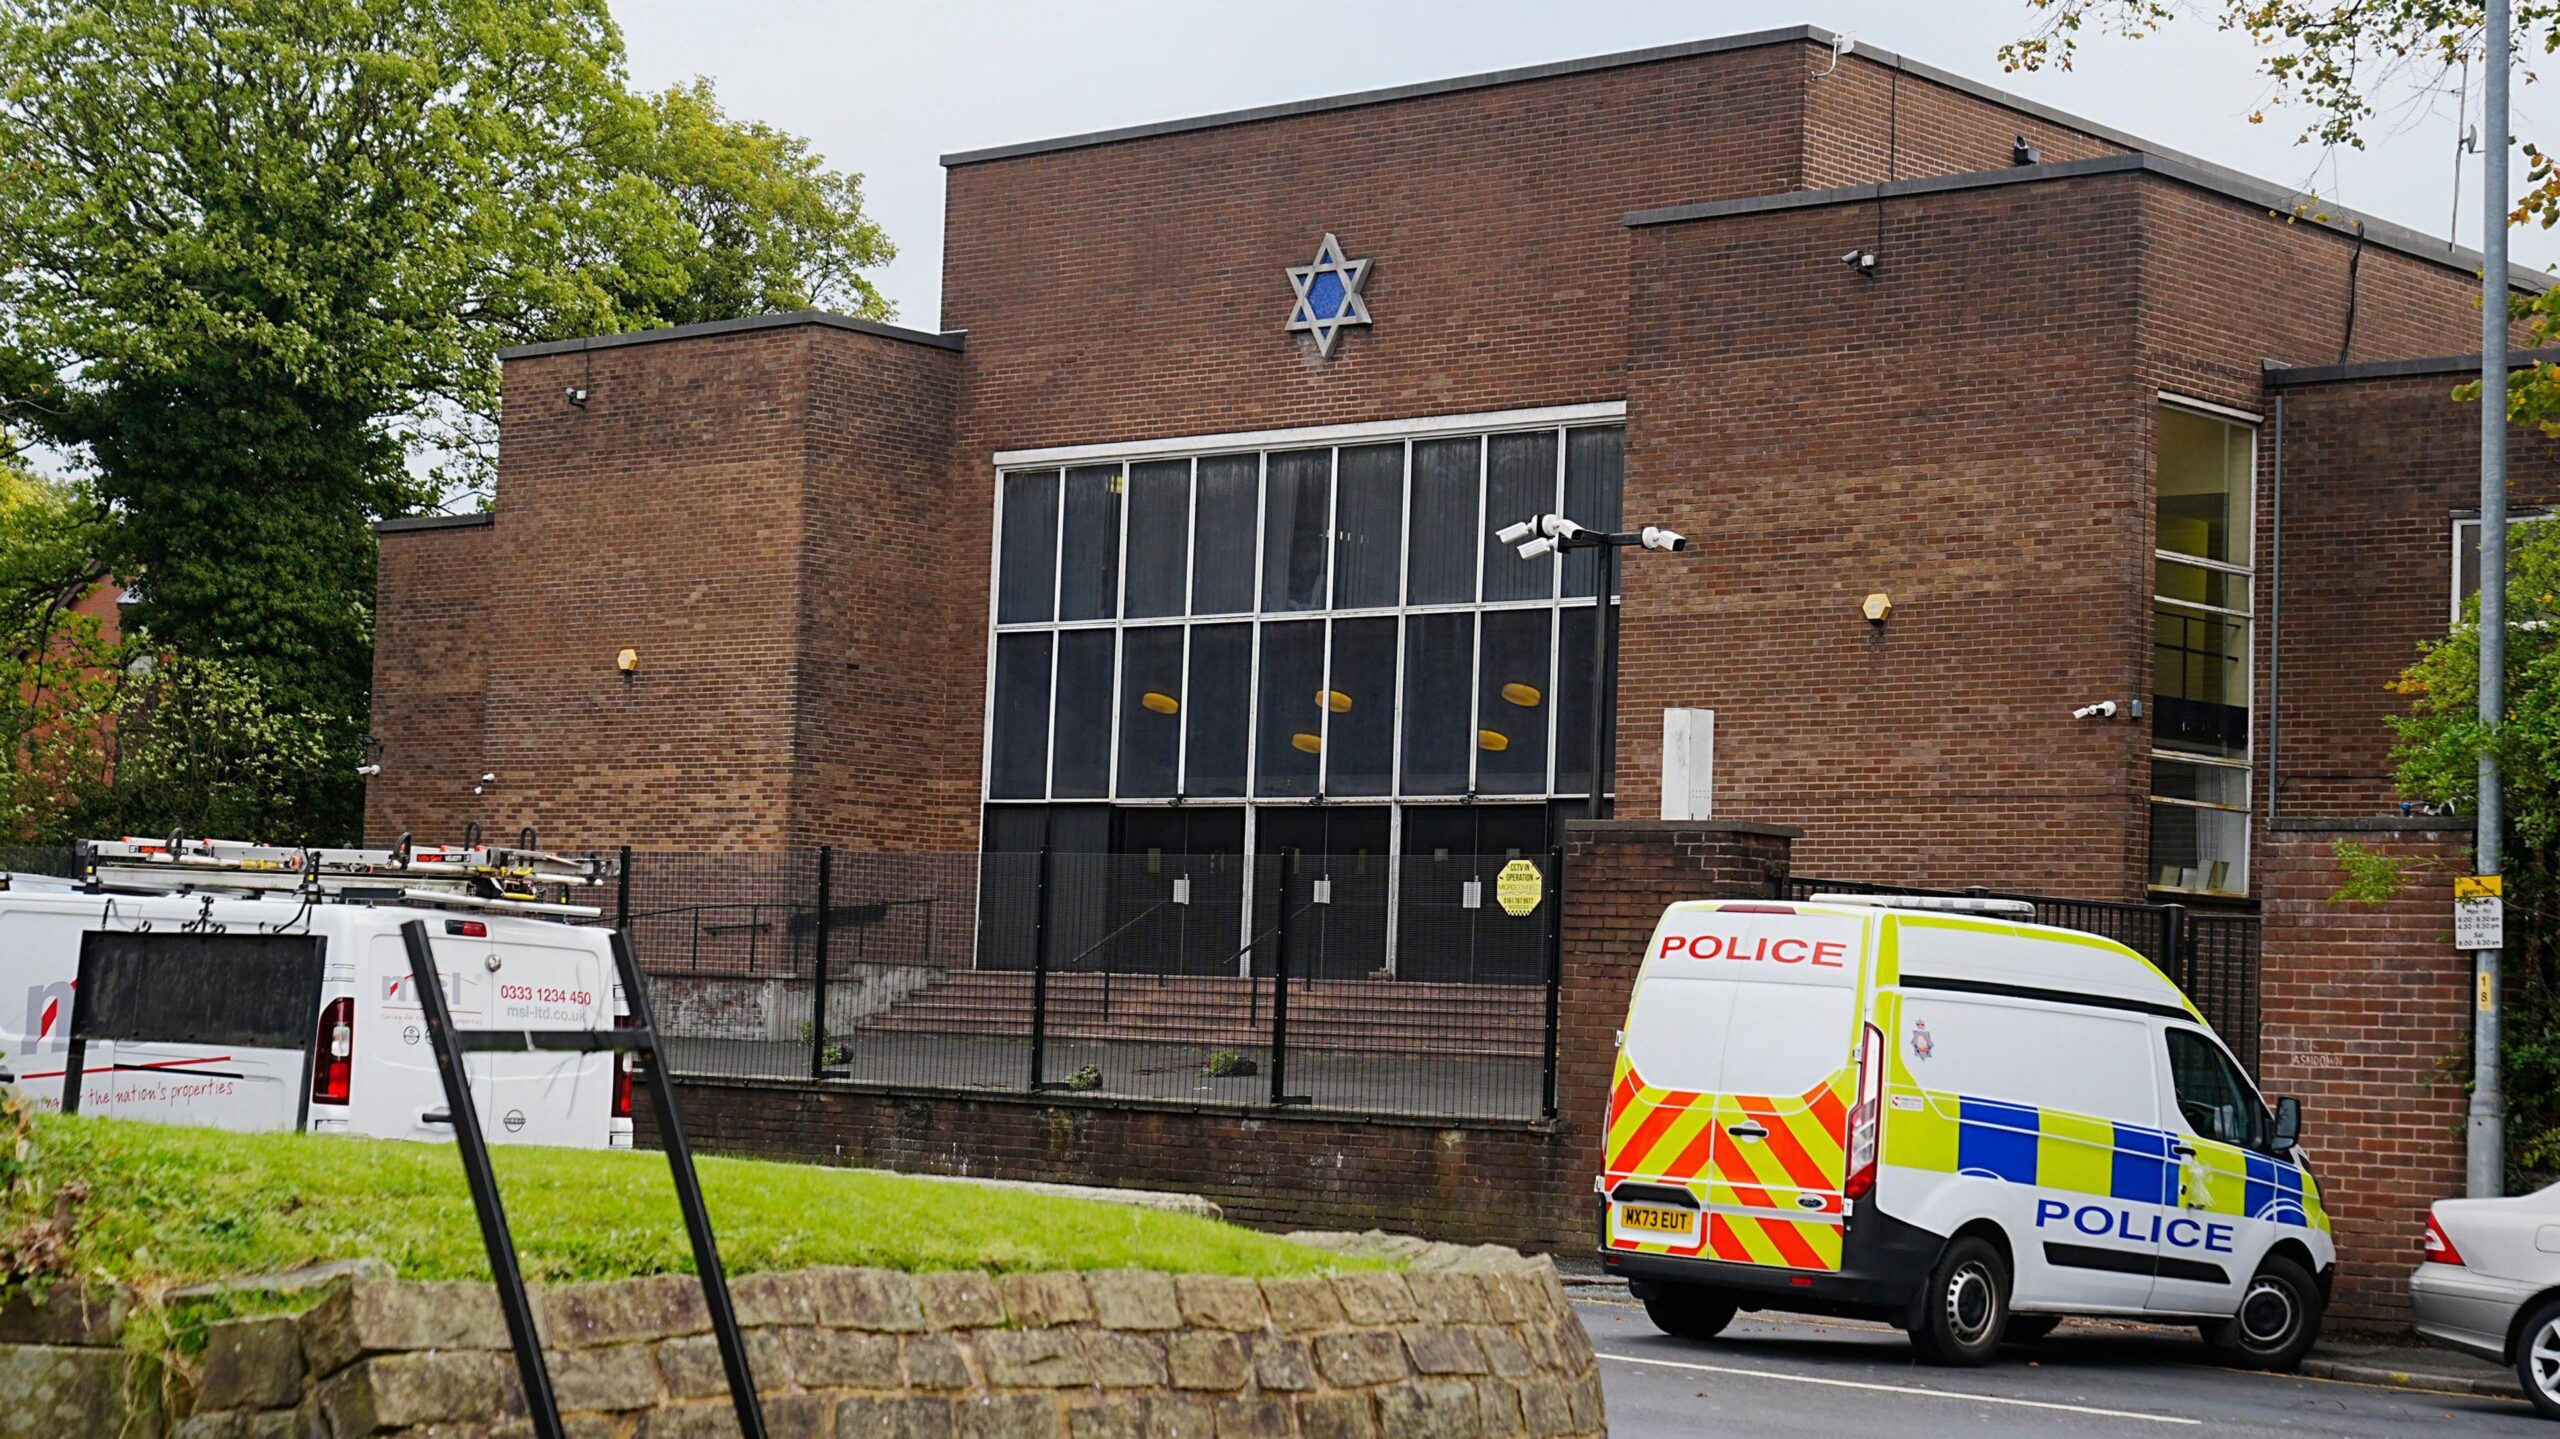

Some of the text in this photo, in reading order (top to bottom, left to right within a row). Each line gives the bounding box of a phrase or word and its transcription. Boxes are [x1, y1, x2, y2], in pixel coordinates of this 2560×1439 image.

[1506, 873, 1534, 881] OPERATION
[1510, 863, 1523, 871] CCTV
[1659, 935, 1847, 967] POLICE
[501, 985, 592, 1006] 0333 1234 450
[507, 1006, 586, 1021] msl-ltd.co.uk
[2293, 1055, 2343, 1066] ASHDOWN
[89, 1079, 233, 1106] the nation's properties
[1626, 1208, 1688, 1230] MX73 EUT
[2035, 1199, 2234, 1253] POLICE
